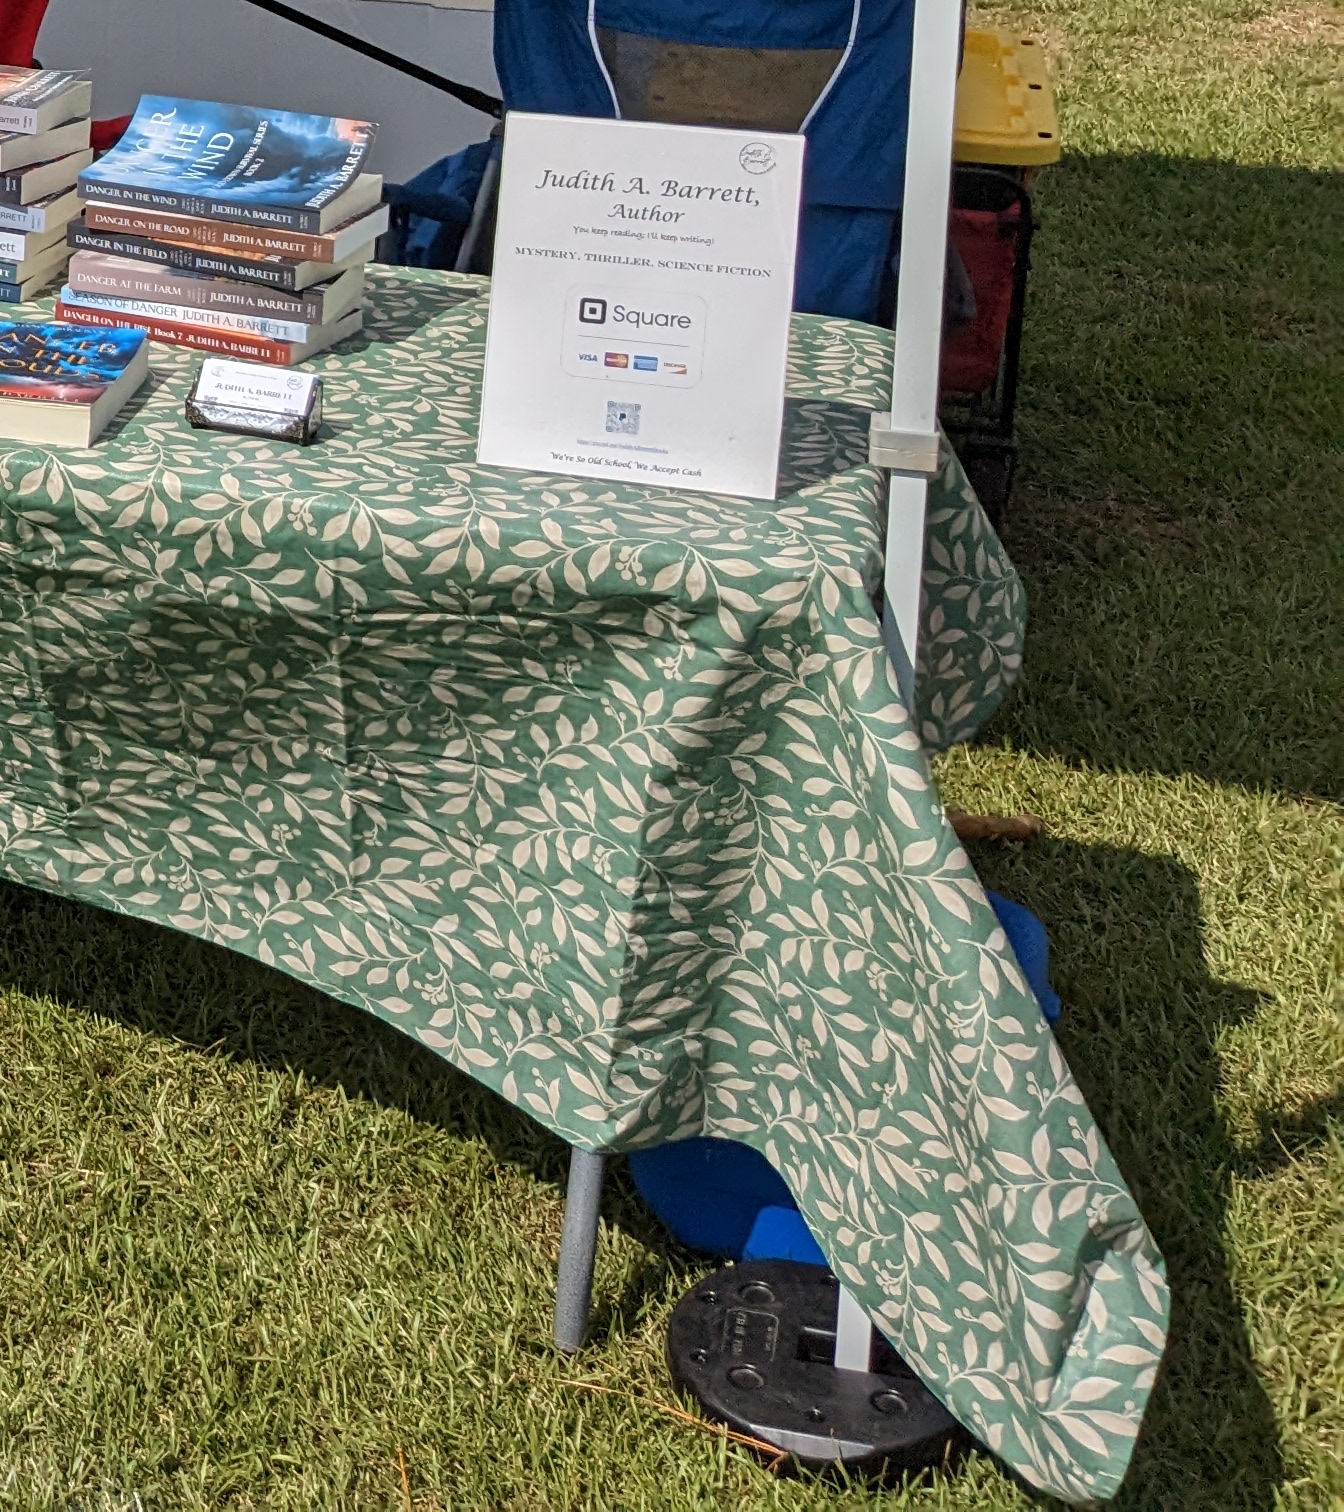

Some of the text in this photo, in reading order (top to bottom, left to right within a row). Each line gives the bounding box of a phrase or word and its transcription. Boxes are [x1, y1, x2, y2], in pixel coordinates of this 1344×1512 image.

[86, 184, 292, 224] DANGER IN THE WIND JUDITH BARRETT
[535, 169, 761, 207] Judith A. Barrett,
[607, 203, 685, 223] Author
[515, 246, 772, 278] MYSTERY. THRILLER. SCIENCE FICTION
[77, 273, 303, 313] DANGER AT THE FARM JUDITH BARRETT
[69, 291, 290, 335] SEASON OF DANGER JUDITH BARRETT
[613, 305, 692, 329] Square
[578, 353, 598, 363] VISA
[550, 452, 574, 461] We're
[588, 457, 603, 465] Old
[634, 461, 648, 471] We
[650, 465, 679, 475] Accept
[682, 468, 702, 477] Cash
